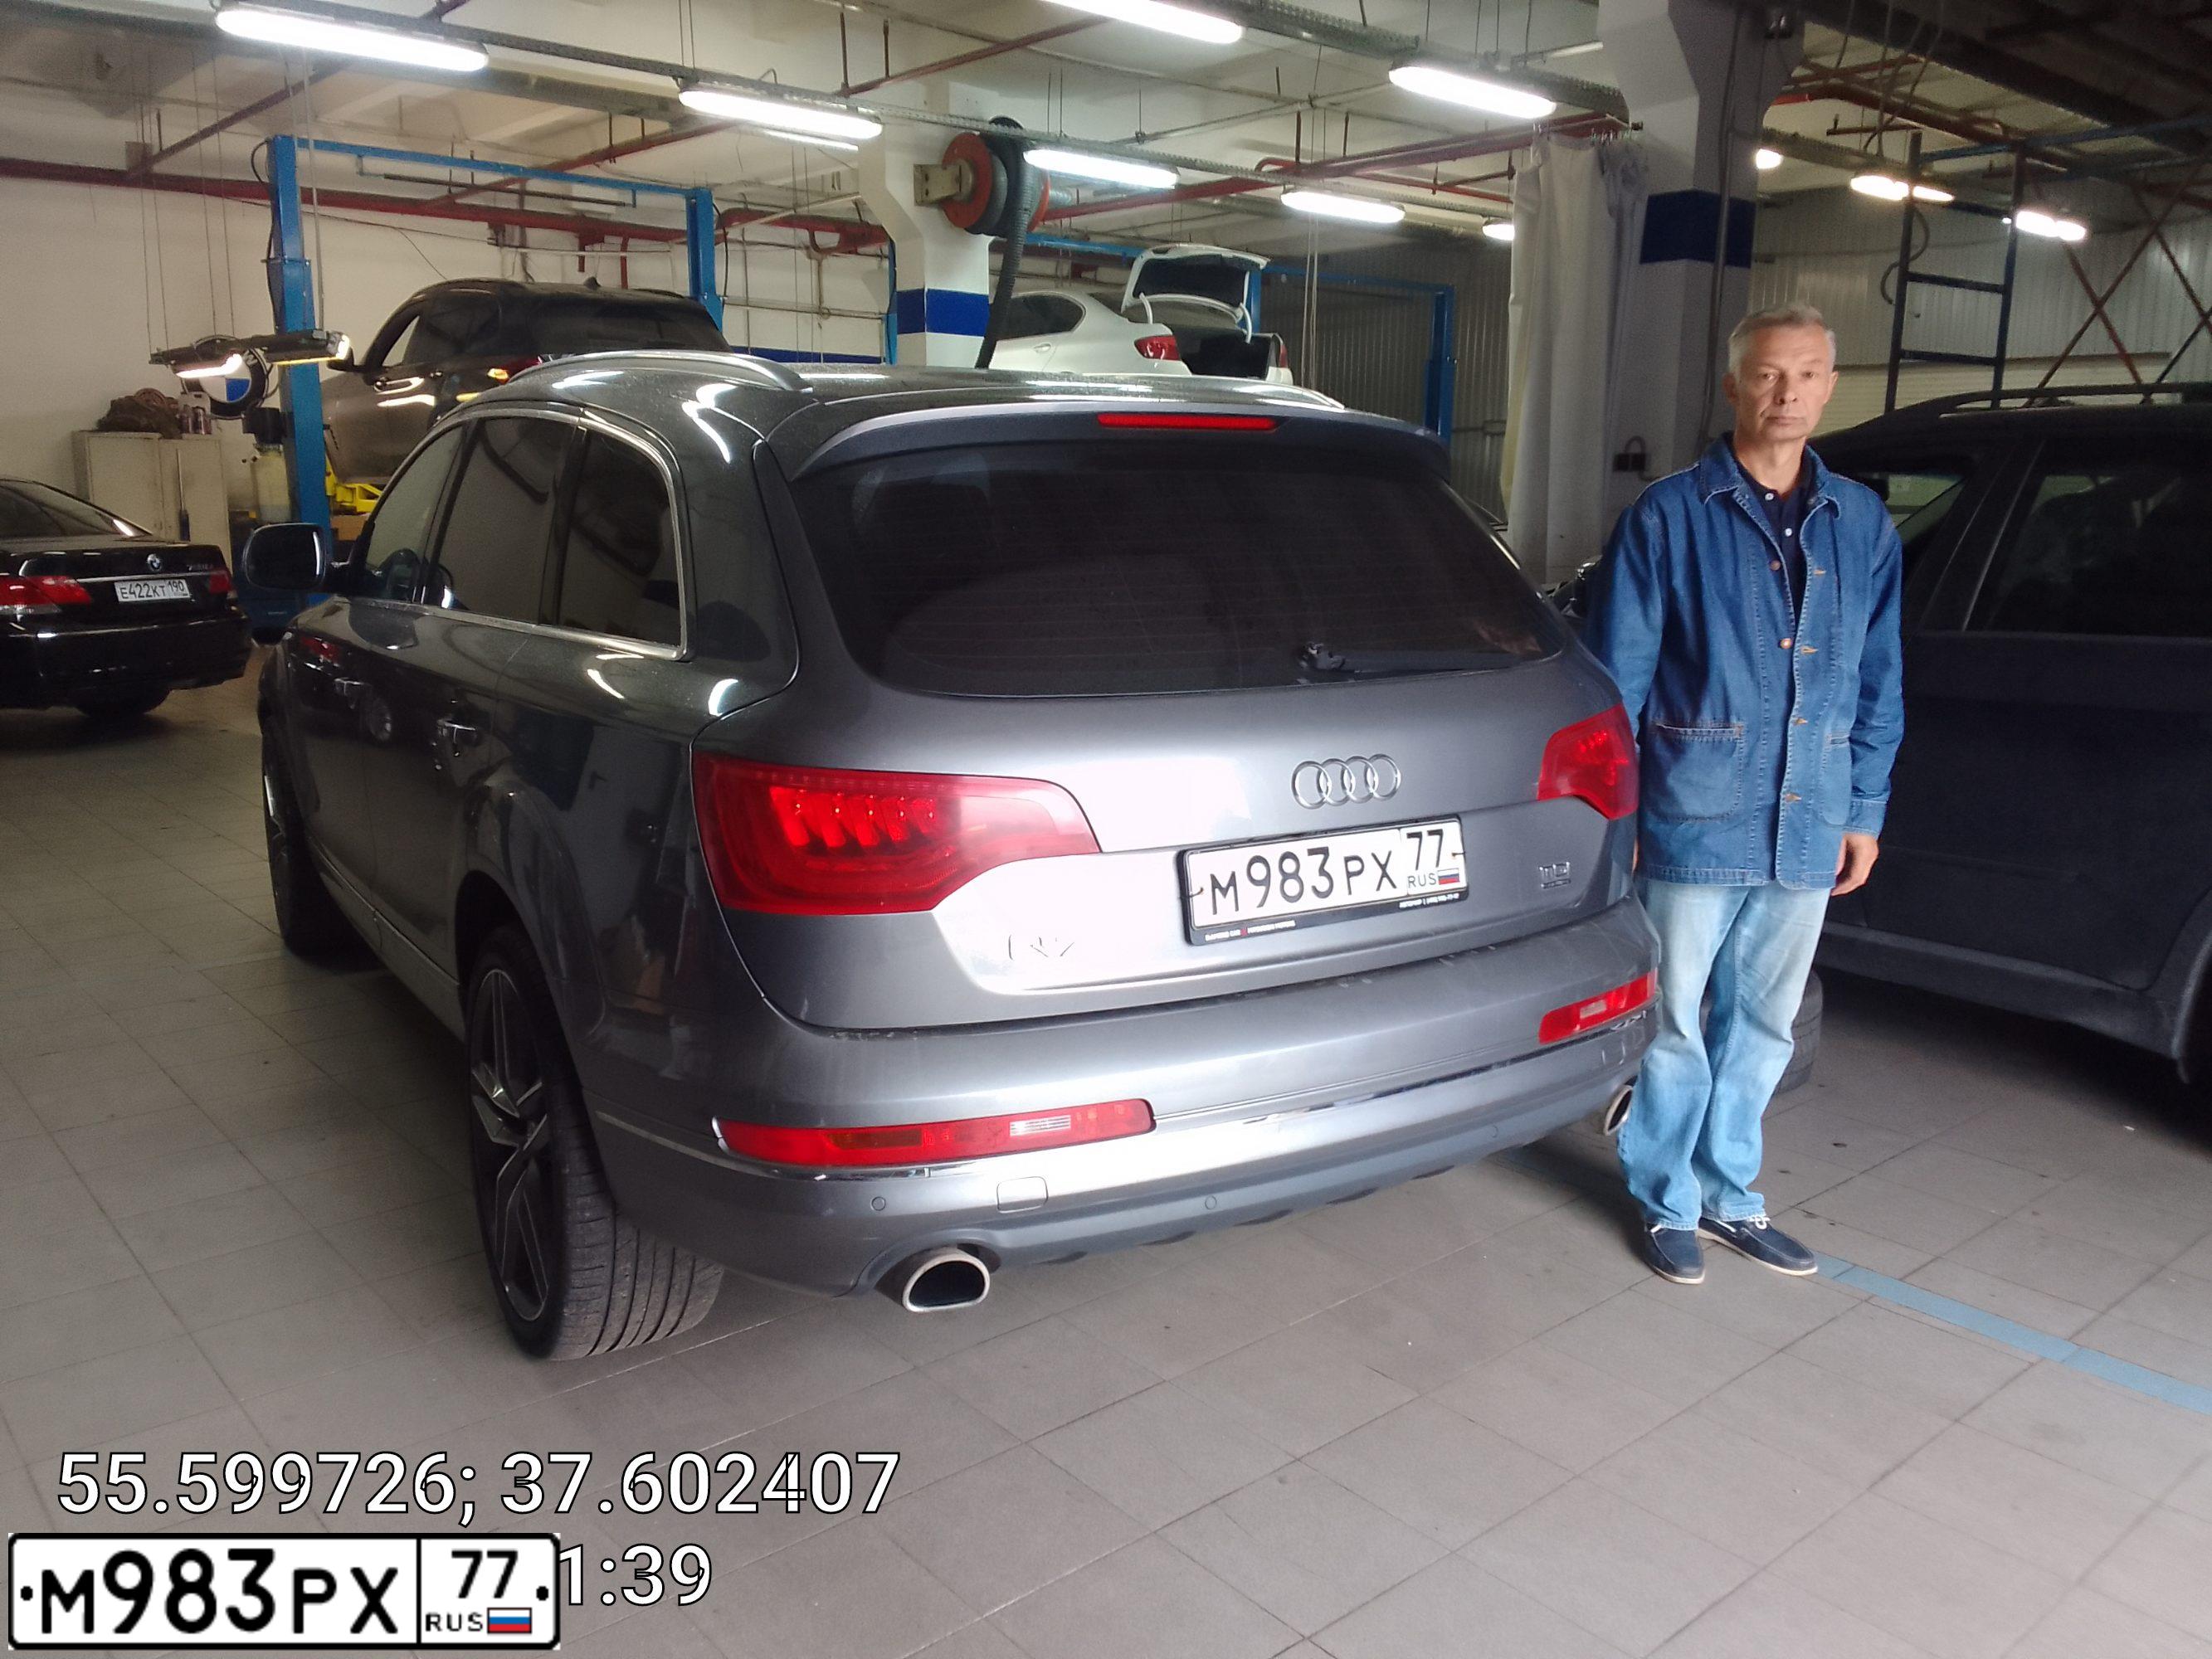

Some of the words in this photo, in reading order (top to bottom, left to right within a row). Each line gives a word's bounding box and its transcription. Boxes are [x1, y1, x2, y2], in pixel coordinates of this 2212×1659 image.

[168, 581, 185, 592] 190
[1210, 846, 1397, 916] M983PX
[1406, 829, 1444, 870] 77
[1406, 872, 1437, 889] RUS
